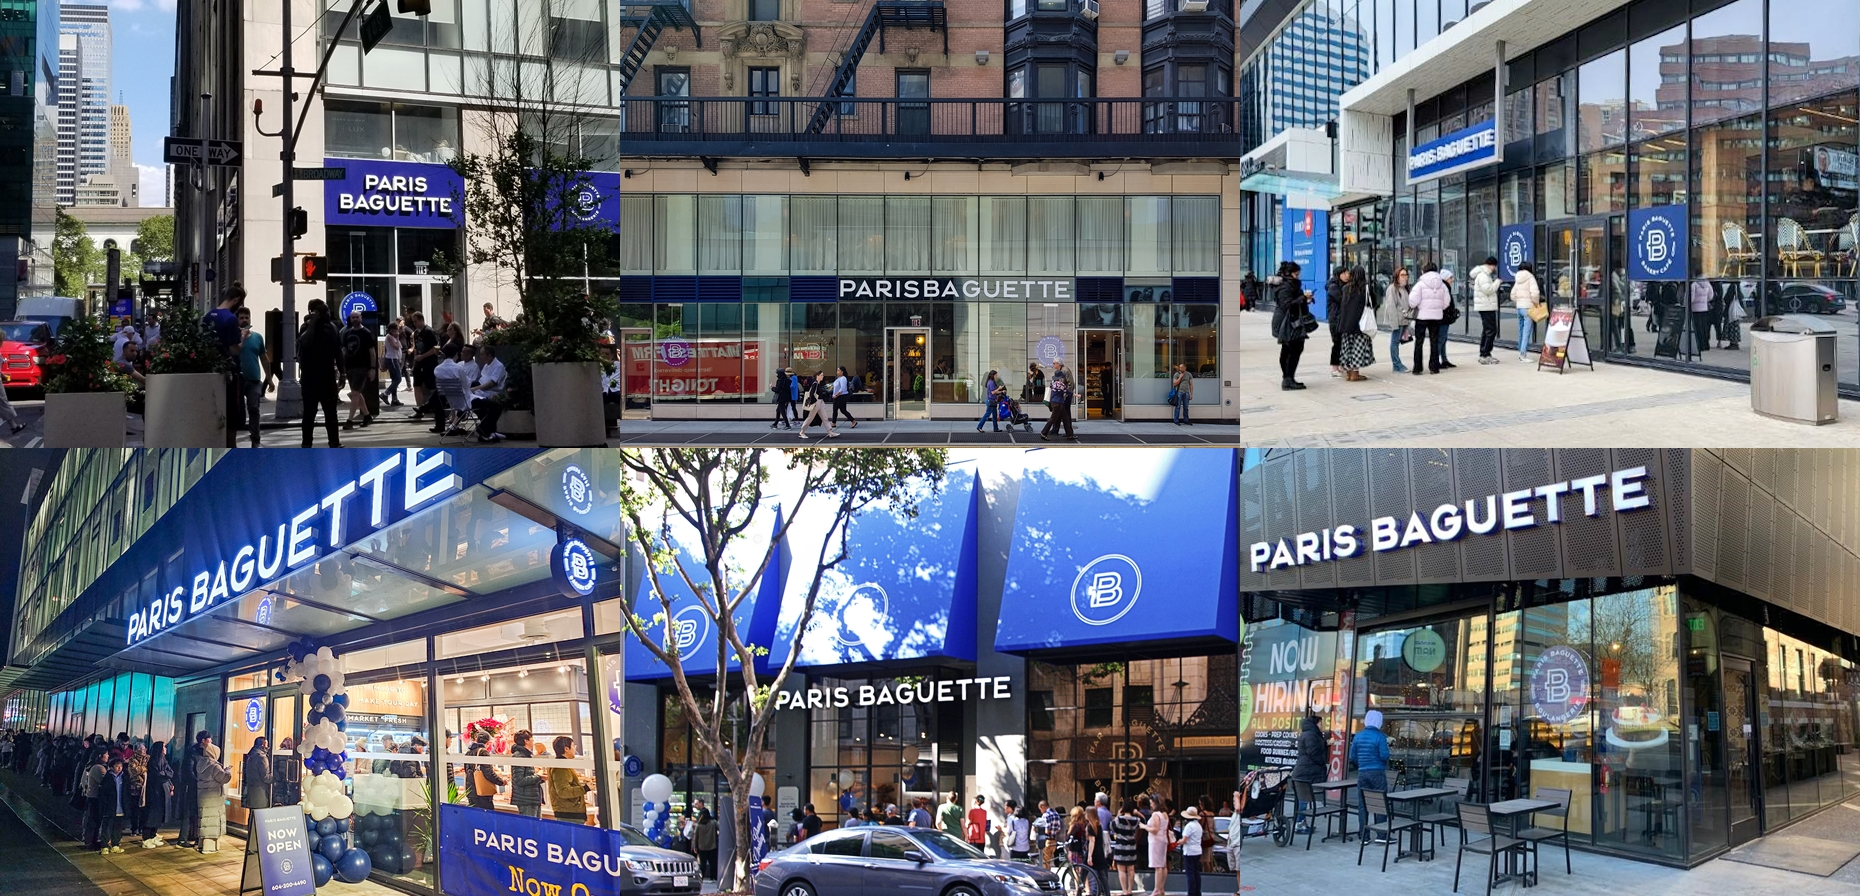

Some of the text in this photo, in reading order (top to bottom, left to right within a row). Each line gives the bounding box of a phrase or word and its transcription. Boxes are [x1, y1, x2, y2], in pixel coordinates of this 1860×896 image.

[176, 146, 231, 159] ONE WAY
[1409, 128, 1495, 170] PARIS BAGUETTE
[303, 169, 344, 179] BROADWAY
[365, 174, 428, 192] PARIS
[340, 193, 453, 213] BAGUETTE
[1638, 215, 1675, 241] PARIS BAGUETTE
[1250, 466, 1650, 573] PARIS BAGUETTE
[127, 448, 458, 645] PARIS BAGUETTE
[1269, 636, 1319, 675] NOW
[1532, 649, 1584, 680] PARIS BAGUETTE
[358, 697, 379, 705] MAKE
[382, 699, 403, 707] YOUR
[775, 676, 1011, 710] PARIS BAGUETTE
[1254, 679, 1332, 714] HIRING!
[1535, 700, 1582, 722] BOULANGERIE
[1251, 717, 1267, 730] ALL
[1260, 747, 1272, 755] FOOD
[267, 827, 297, 841] NOW
[474, 828, 539, 859] PARIS
[266, 839, 302, 854] OPEN
